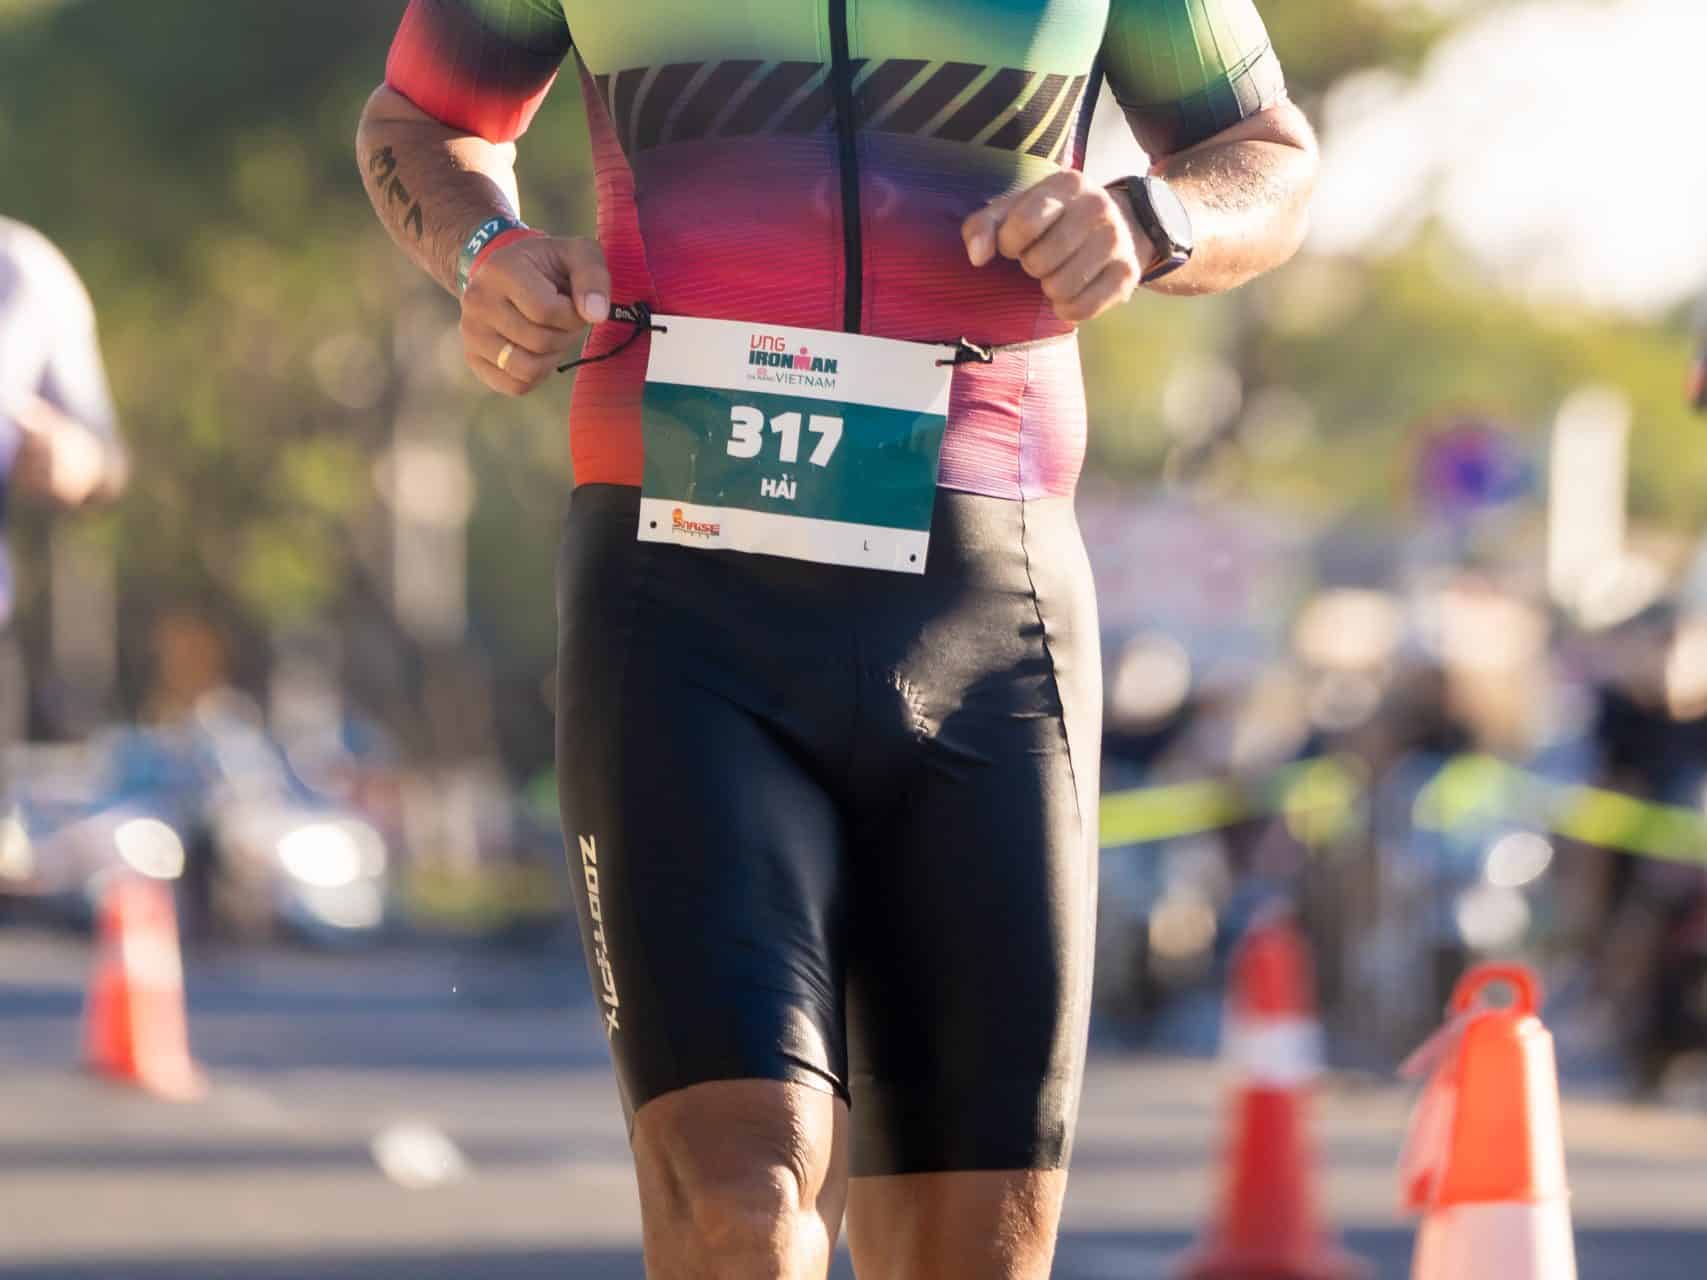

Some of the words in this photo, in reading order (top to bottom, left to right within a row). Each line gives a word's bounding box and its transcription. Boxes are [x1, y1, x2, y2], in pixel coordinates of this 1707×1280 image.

[467, 219, 499, 254] 317
[748, 346, 838, 374] IRONMAN
[775, 370, 836, 389] VIETNAM
[726, 405, 844, 468] 317
